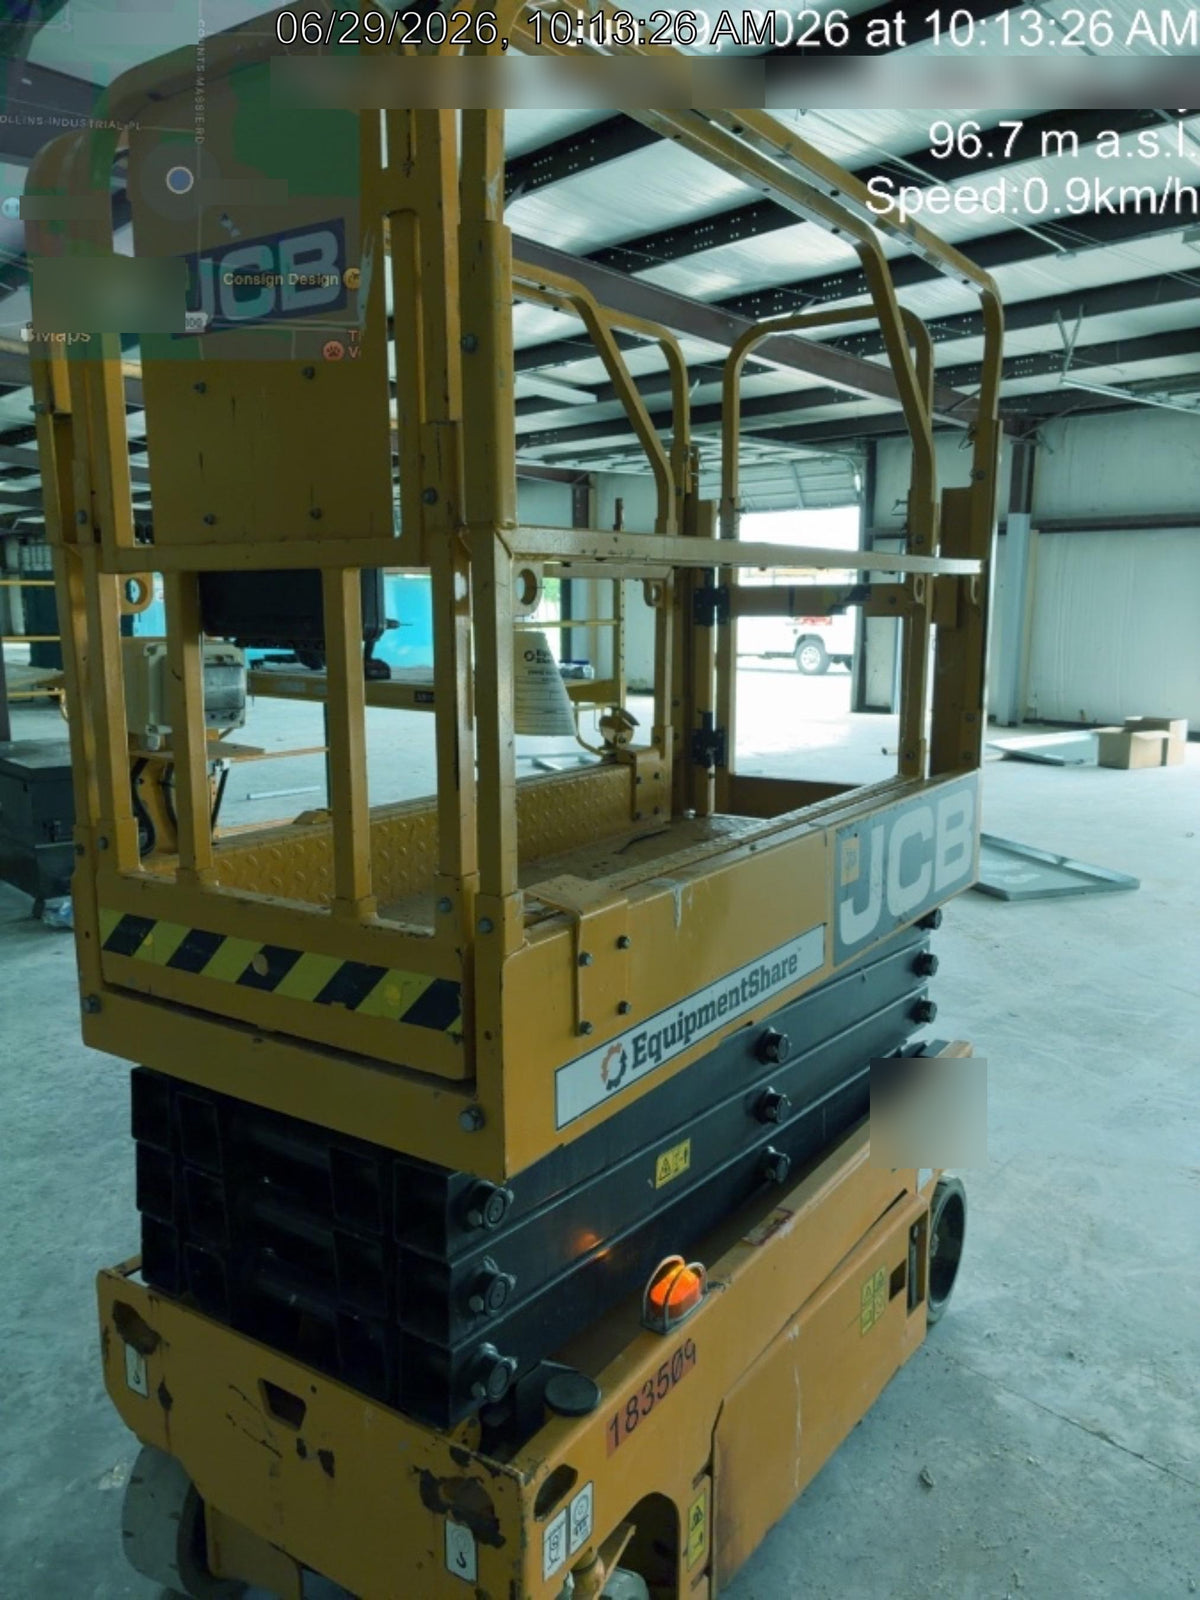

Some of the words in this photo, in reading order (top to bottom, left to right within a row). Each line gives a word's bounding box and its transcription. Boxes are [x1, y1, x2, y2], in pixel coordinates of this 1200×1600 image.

[838, 787, 975, 946] JCB
[631, 953, 798, 1070] EquipmentShare
[607, 1337, 698, 1449] 183509
